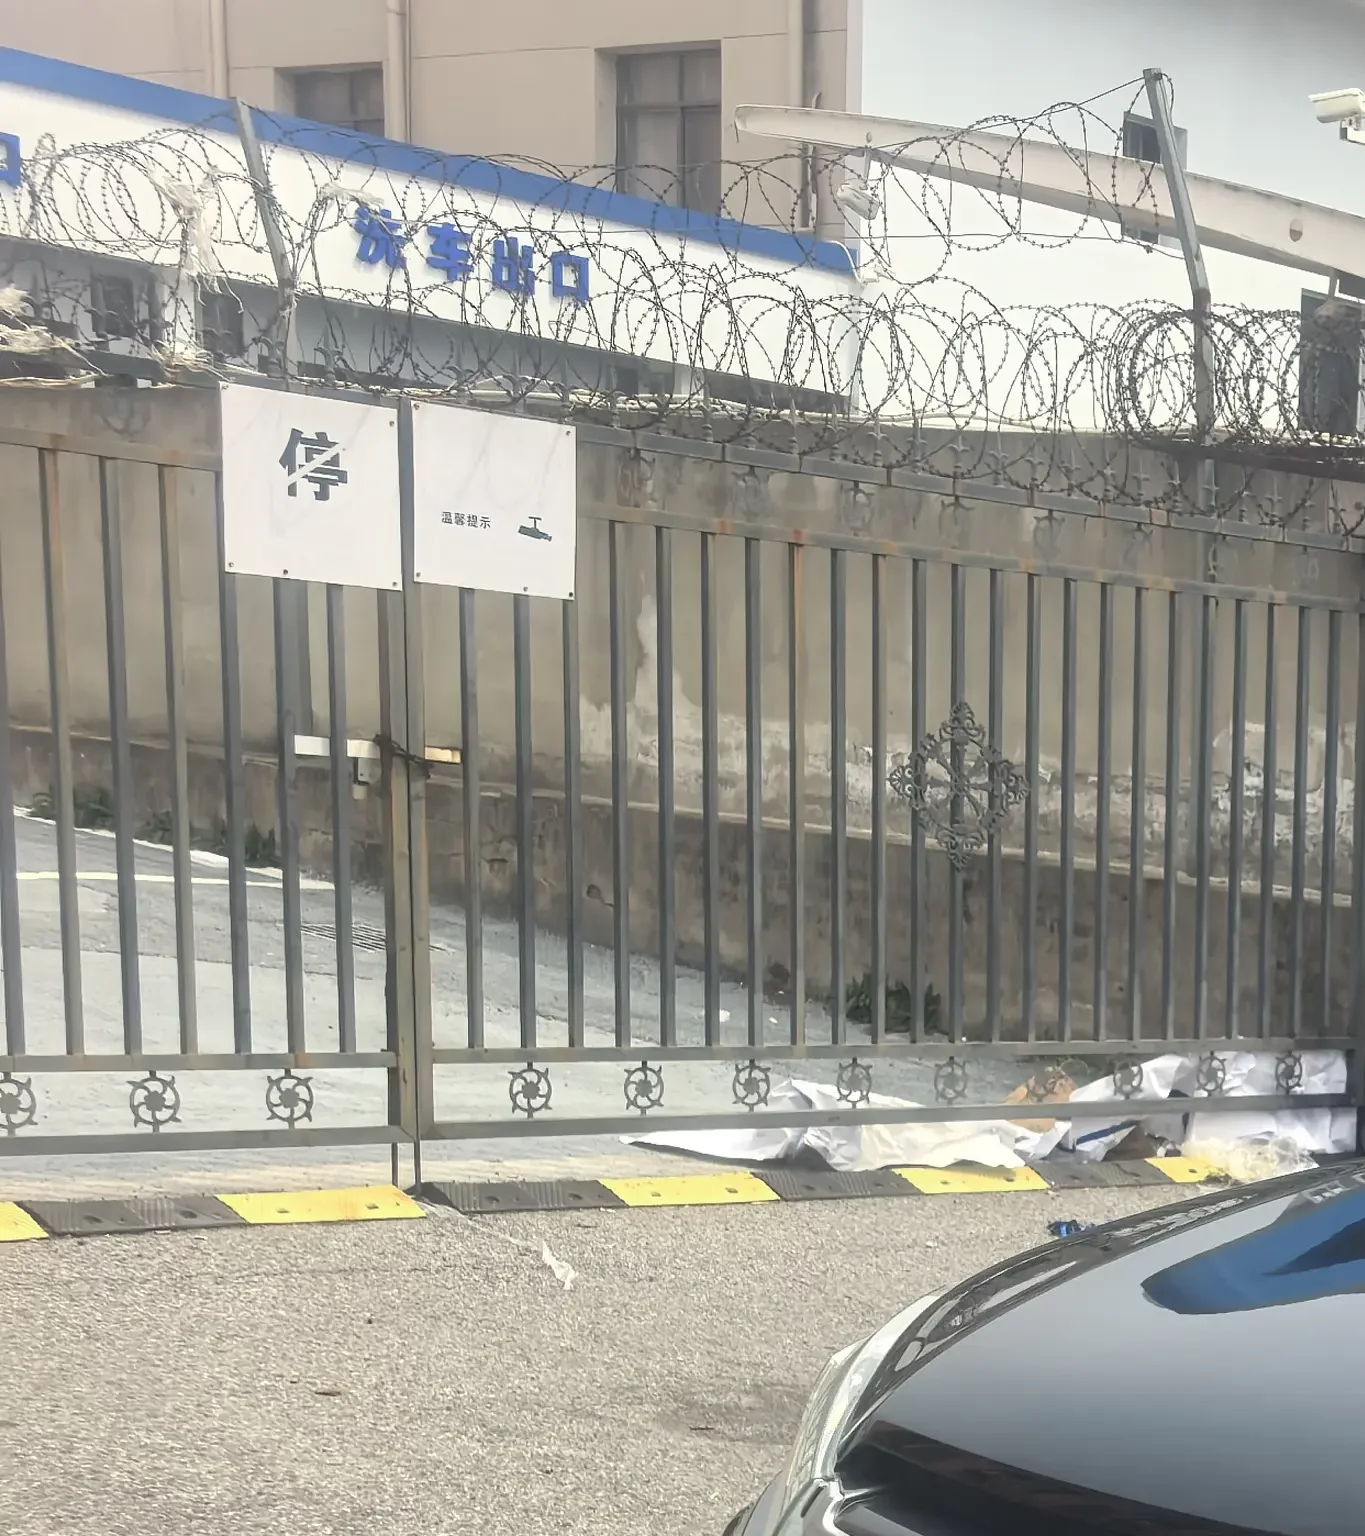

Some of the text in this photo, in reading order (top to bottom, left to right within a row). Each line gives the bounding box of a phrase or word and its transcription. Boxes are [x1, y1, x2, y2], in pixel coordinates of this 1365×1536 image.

[354, 206, 590, 306] 洗车出口
[279, 427, 348, 502] 停
[441, 511, 491, 529] 温馨提示
